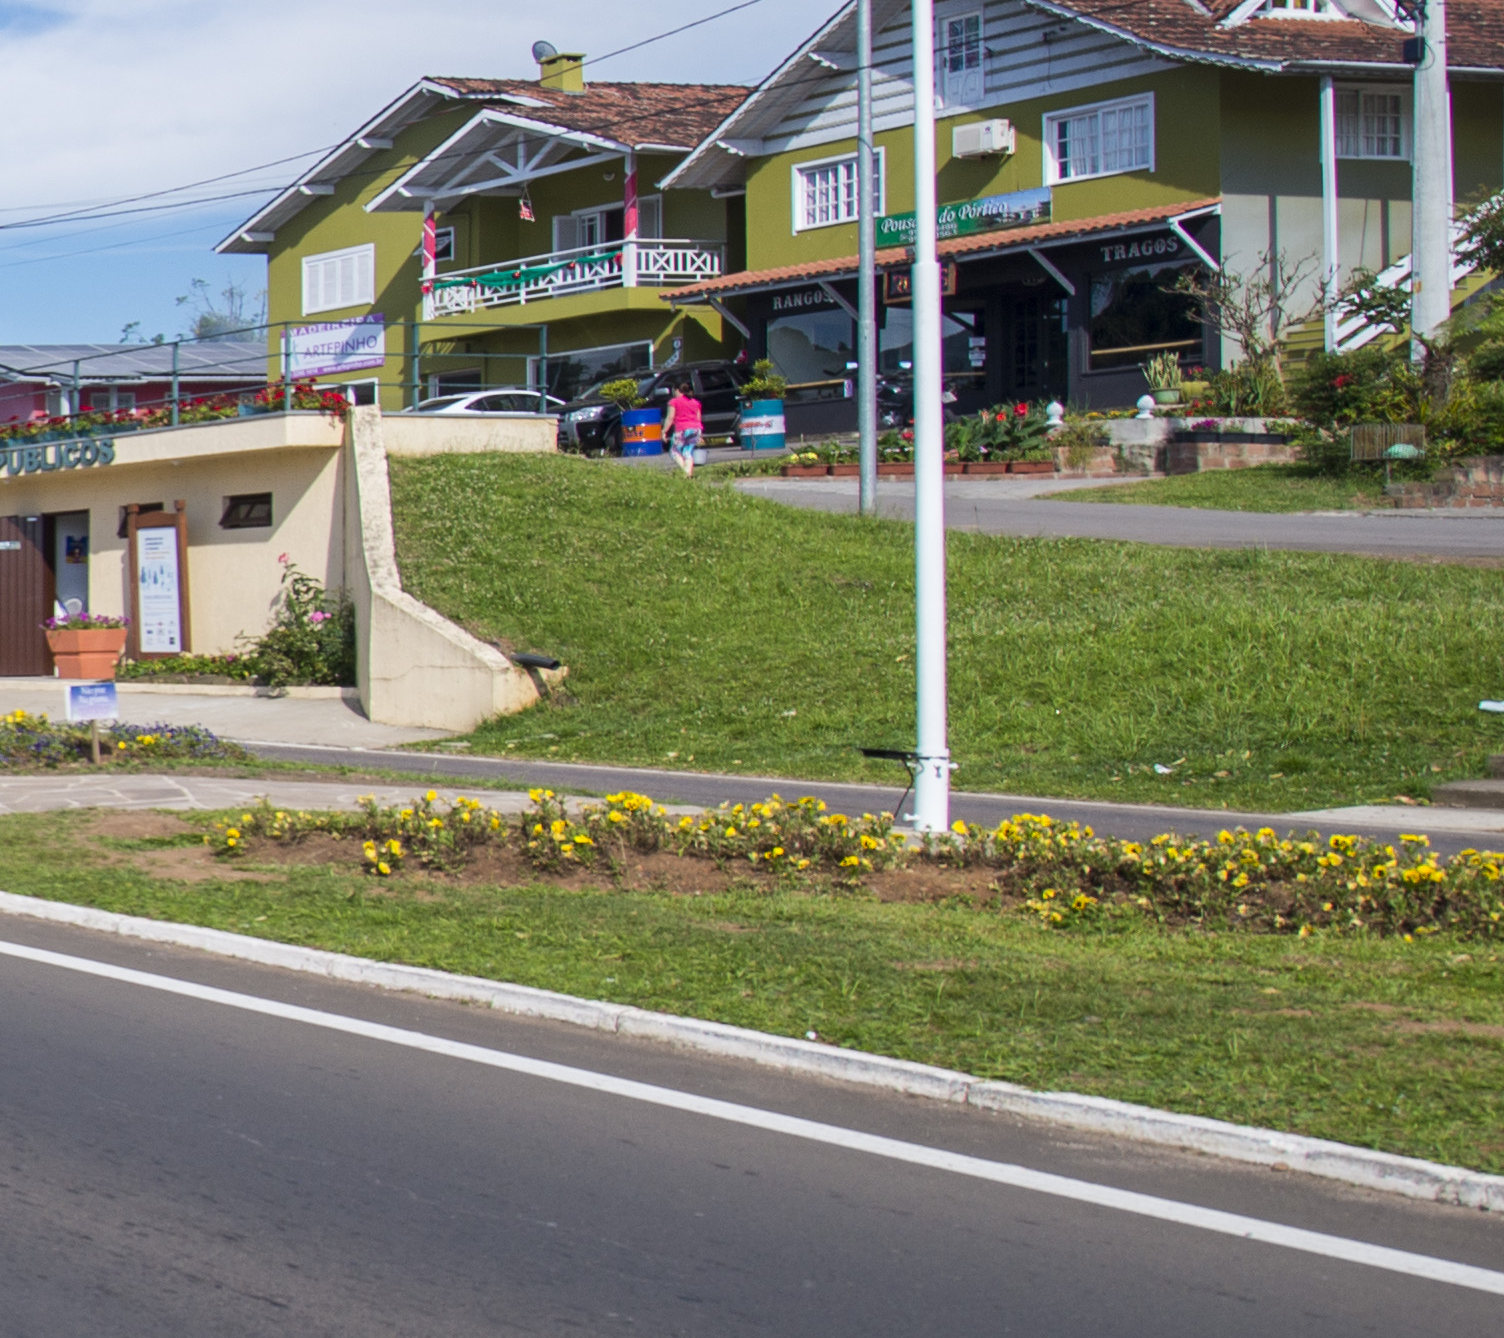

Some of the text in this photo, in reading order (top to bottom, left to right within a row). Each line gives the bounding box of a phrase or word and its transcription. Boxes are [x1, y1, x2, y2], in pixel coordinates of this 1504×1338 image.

[939, 204, 956, 224] do
[958, 201, 1008, 221] Pórtico
[1100, 236, 1178, 262] TRAGOS
[304, 335, 378, 359] ARTEPINHO
